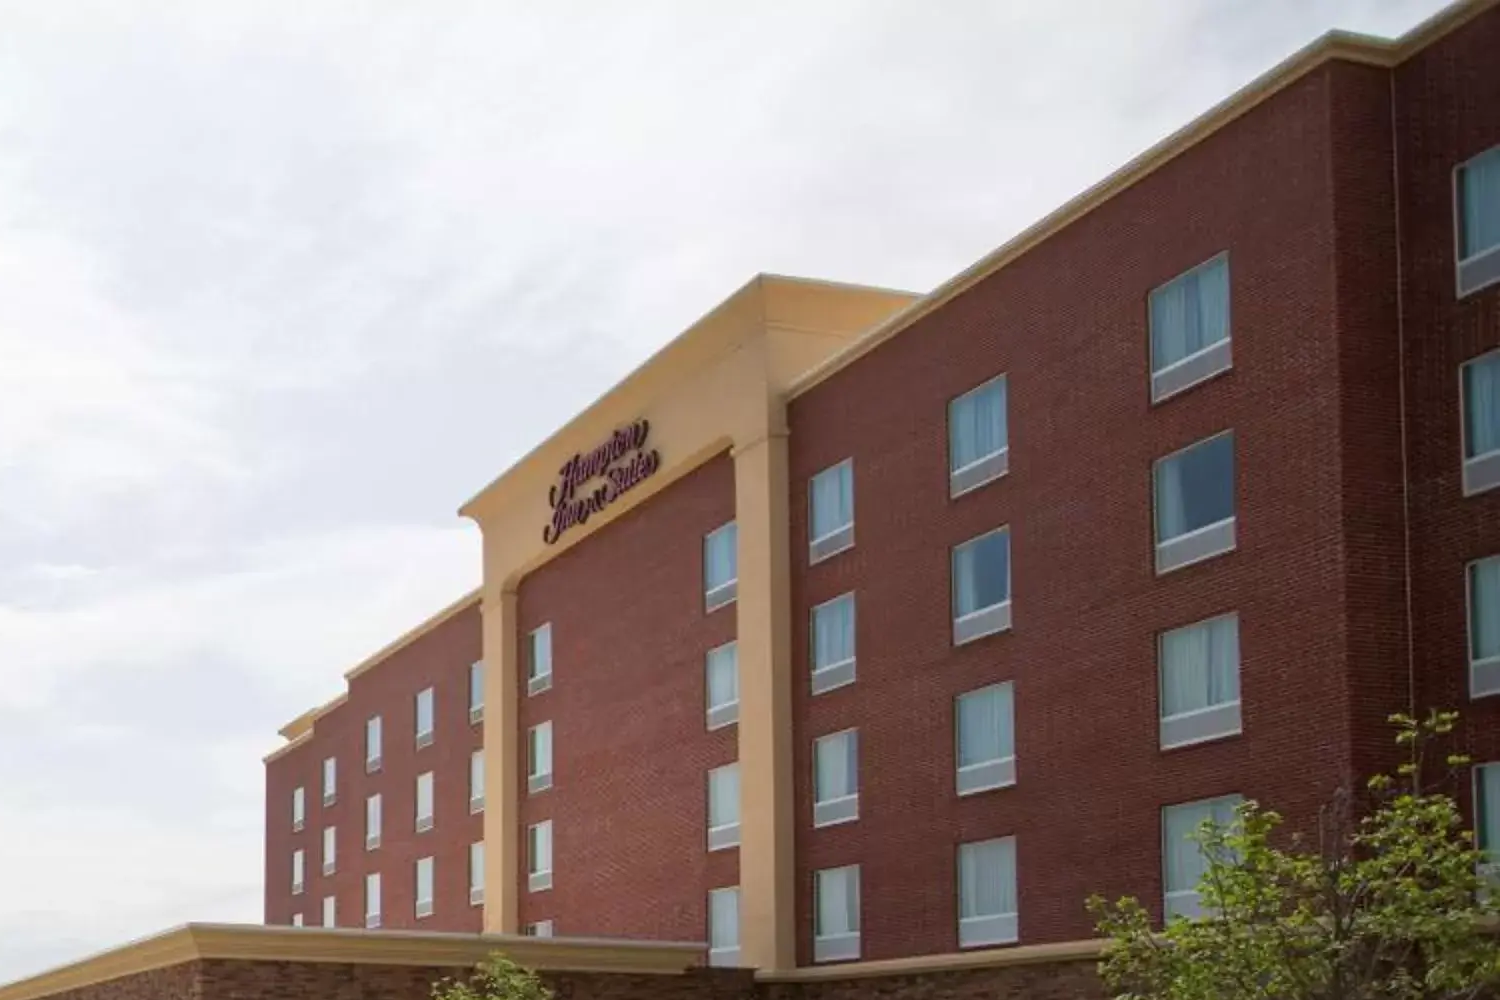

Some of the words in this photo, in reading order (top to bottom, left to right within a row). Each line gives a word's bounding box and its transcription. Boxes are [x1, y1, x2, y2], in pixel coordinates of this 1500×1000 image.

[544, 501, 589, 544] Inn
[607, 449, 660, 503] Suites
[549, 420, 649, 507] Hampton
